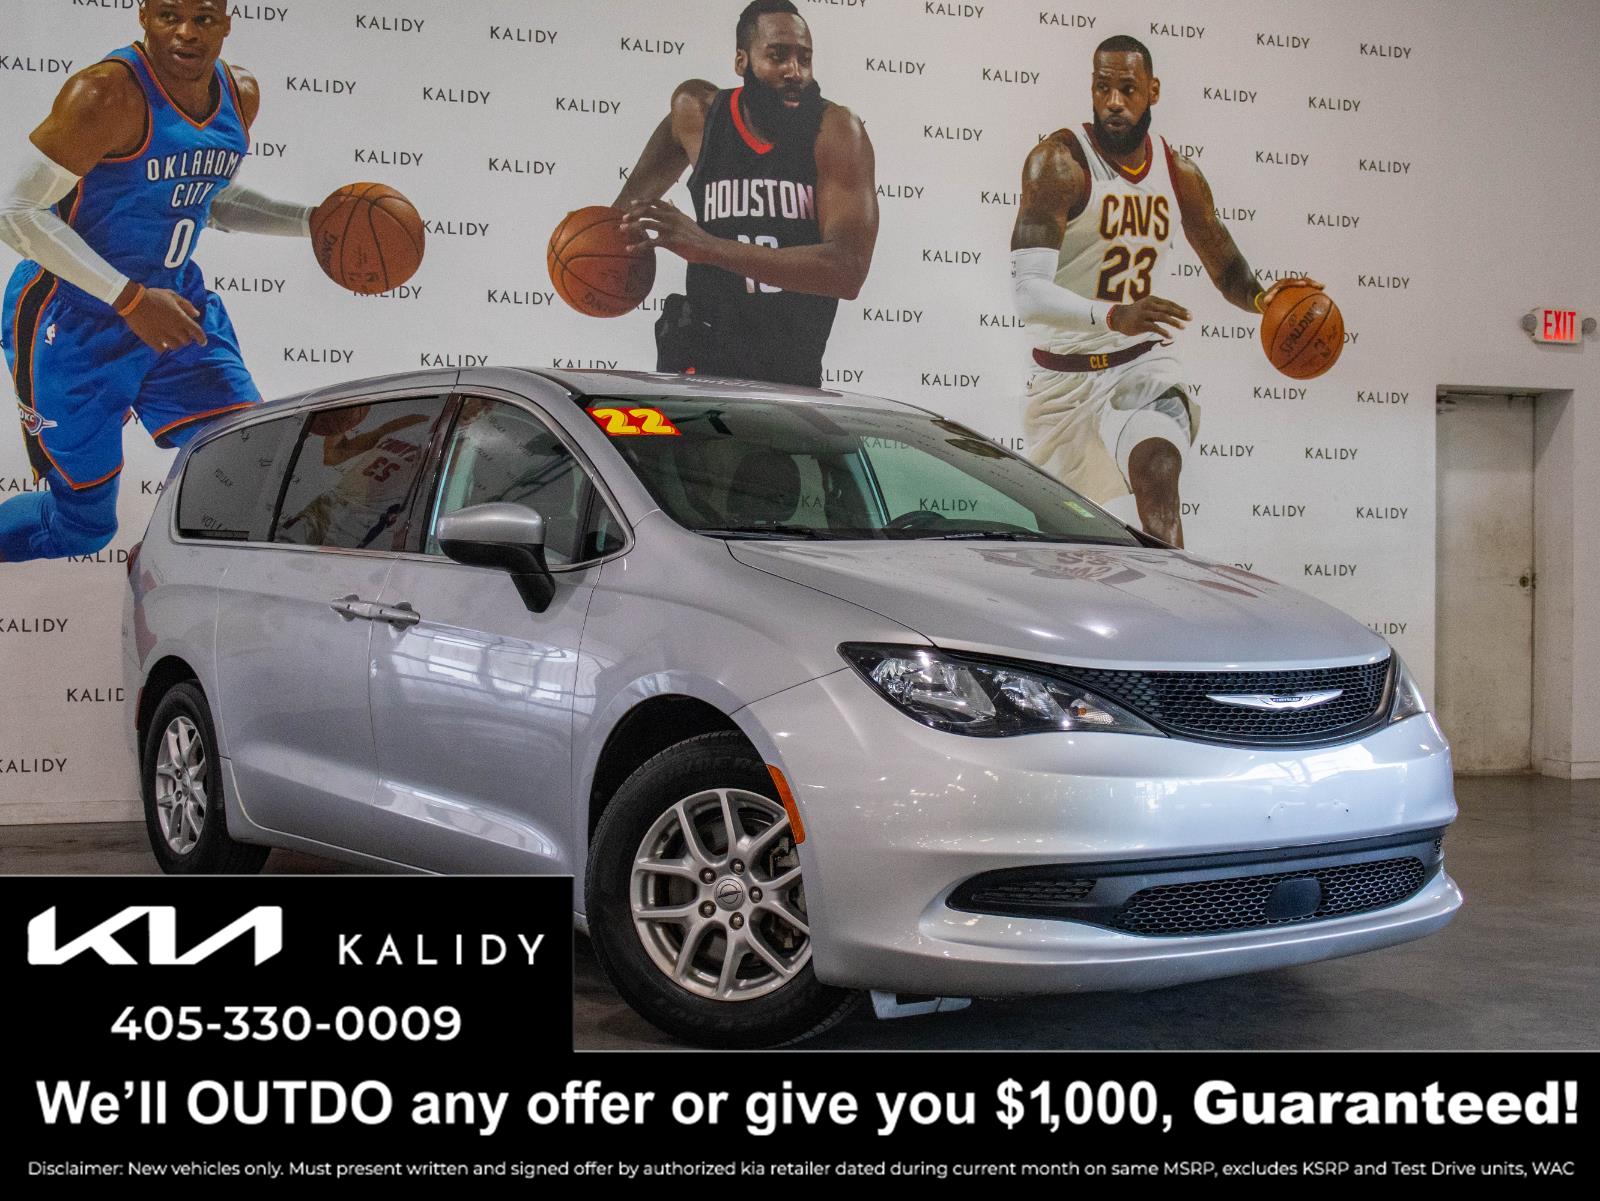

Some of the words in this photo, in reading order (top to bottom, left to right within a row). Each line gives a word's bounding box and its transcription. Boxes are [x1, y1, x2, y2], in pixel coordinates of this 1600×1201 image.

[231, 5, 288, 21] ALIDY
[926, 2, 984, 18] KALIDY
[357, 15, 424, 32] KALIDY
[1040, 12, 1096, 28] KALIDY
[491, 26, 557, 44] KALIDY
[1151, 23, 1204, 38] KALIDY
[621, 38, 684, 55] KALIDY
[1257, 34, 1310, 48] KALIDY
[1360, 43, 1411, 59] KALIDY
[0, 56, 72, 73] KALIDY
[867, 58, 925, 75] KALIDY
[983, 68, 1039, 84] KALIDY
[287, 77, 356, 94] KALIDY
[424, 87, 490, 104] KALIDY
[1204, 88, 1256, 103] KALIDY
[557, 98, 620, 114] KALIDY
[1309, 97, 1360, 111] KALIDY
[924, 125, 982, 141] KALIDY
[147, 149, 240, 181] OKLAHOM
[355, 149, 423, 166] KALIDY
[1256, 151, 1308, 166] KALIDY
[489, 158, 555, 175] KALIDY
[1360, 159, 1410, 173] KALIDY
[172, 182, 214, 207] CITY
[876, 185, 924, 199] ALIDY
[981, 192, 1021, 205] KALI
[704, 179, 815, 222] HOUSTON
[1099, 194, 1170, 242] CAVS
[1214, 208, 1256, 221] ALIDY
[1308, 214, 1359, 228] KALIDY
[422, 220, 489, 236] KALIDY
[164, 218, 195, 269] 0
[923, 250, 981, 264] KALIDY
[1096, 246, 1157, 303] 23
[1359, 275, 1409, 288] KALIDY
[215, 277, 285, 293] KALIDY
[488, 290, 554, 305] KALIDY
[864, 308, 922, 323] KALIDY
[1202, 325, 1255, 339] KALIDY
[1544, 310, 1576, 341] EXIT
[285, 348, 353, 363] KALIDY
[421, 353, 488, 367] KALIDY
[1090, 353, 1108, 369] CLE
[820, 370, 863, 383] LIDY
[922, 373, 979, 387] KALIDY
[1254, 387, 1306, 400] KALIDY
[1358, 391, 1408, 404] KALIDY
[591, 408, 674, 435] 22
[1200, 444, 1253, 456] KALIDY
[1306, 448, 1357, 460] KALIDY
[919, 498, 977, 511] KALIDY
[1253, 505, 1305, 517] KALIDY
[1357, 507, 1407, 519] KALIDY
[1305, 564, 1356, 576] KALIDY
[67, 688, 124, 702] KALID
